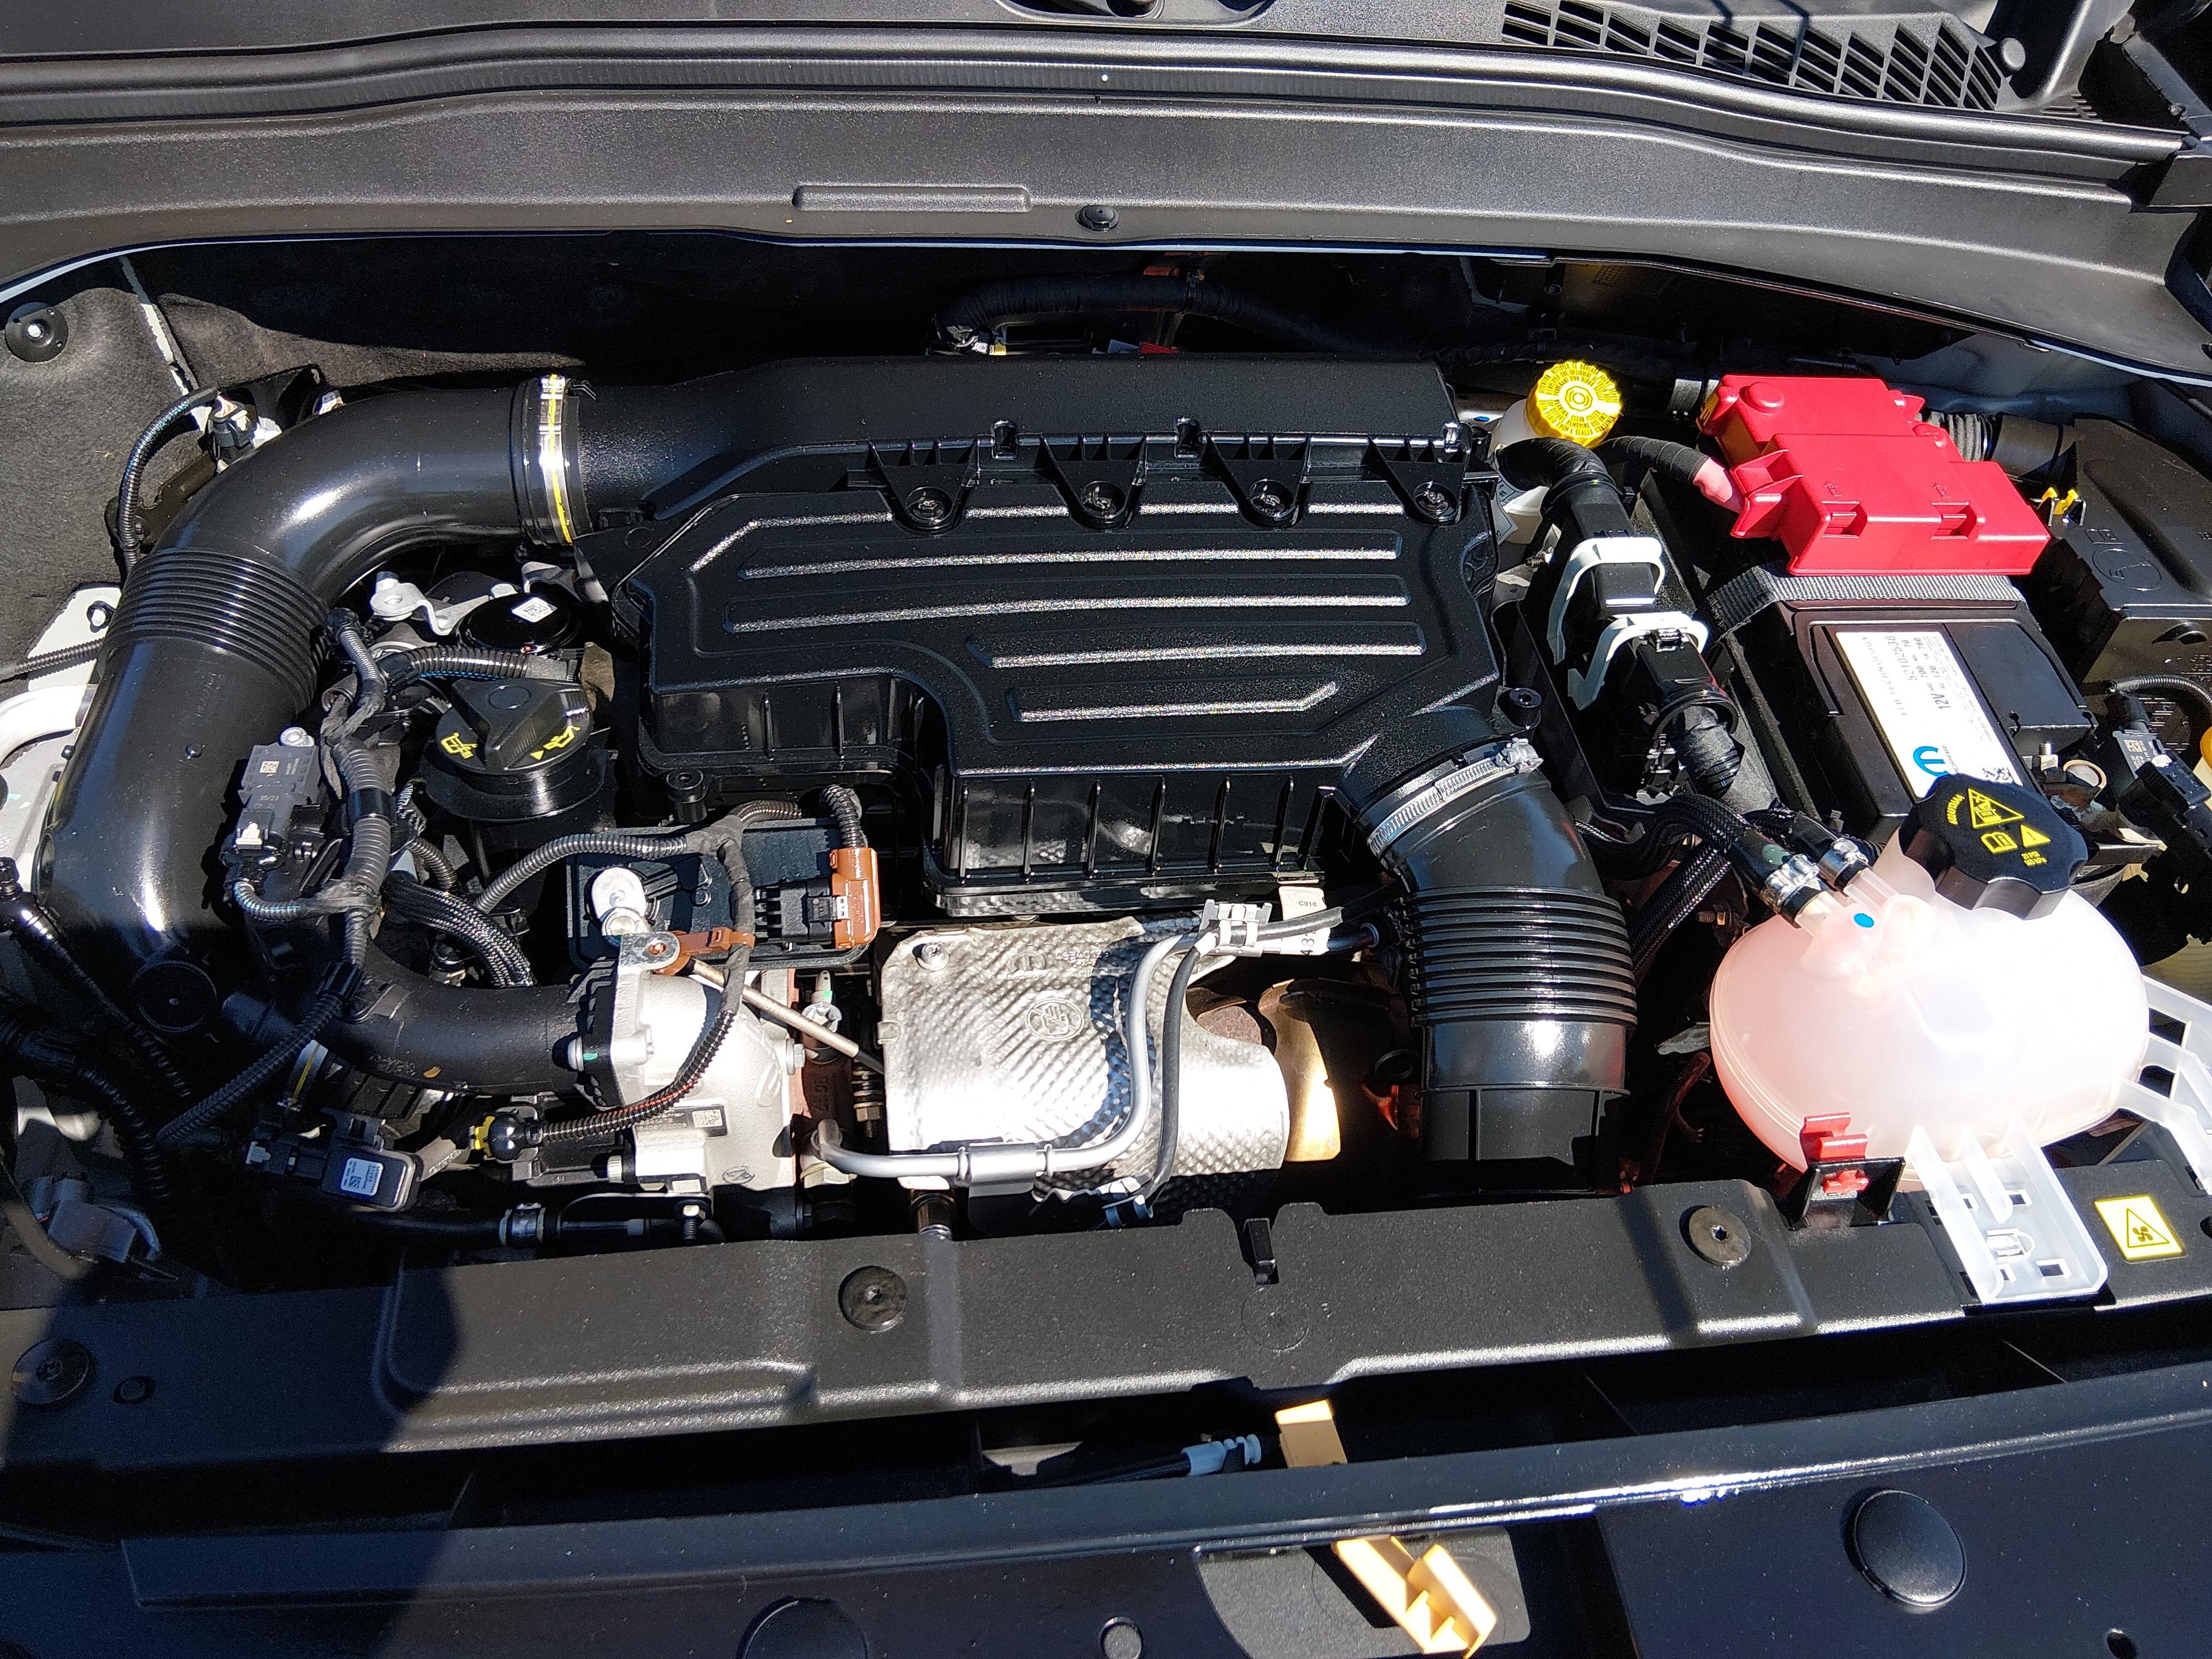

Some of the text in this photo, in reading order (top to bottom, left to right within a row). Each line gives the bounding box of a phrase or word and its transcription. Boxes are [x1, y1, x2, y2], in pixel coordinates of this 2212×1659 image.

[1538, 374, 1551, 393] ATTENTION
[1550, 407, 1566, 423] BEFORE
[1566, 419, 1590, 429] REMOVING
[1586, 410, 1601, 422] FILLER
[1555, 421, 1569, 432] FROM
[1902, 639, 1912, 648] 70
[1914, 638, 1925, 650] 760
[1885, 636, 1917, 681] 52102538
[1916, 666, 1928, 678] 700
[1929, 666, 1941, 677] 120
[1930, 693, 1951, 710] 12V
